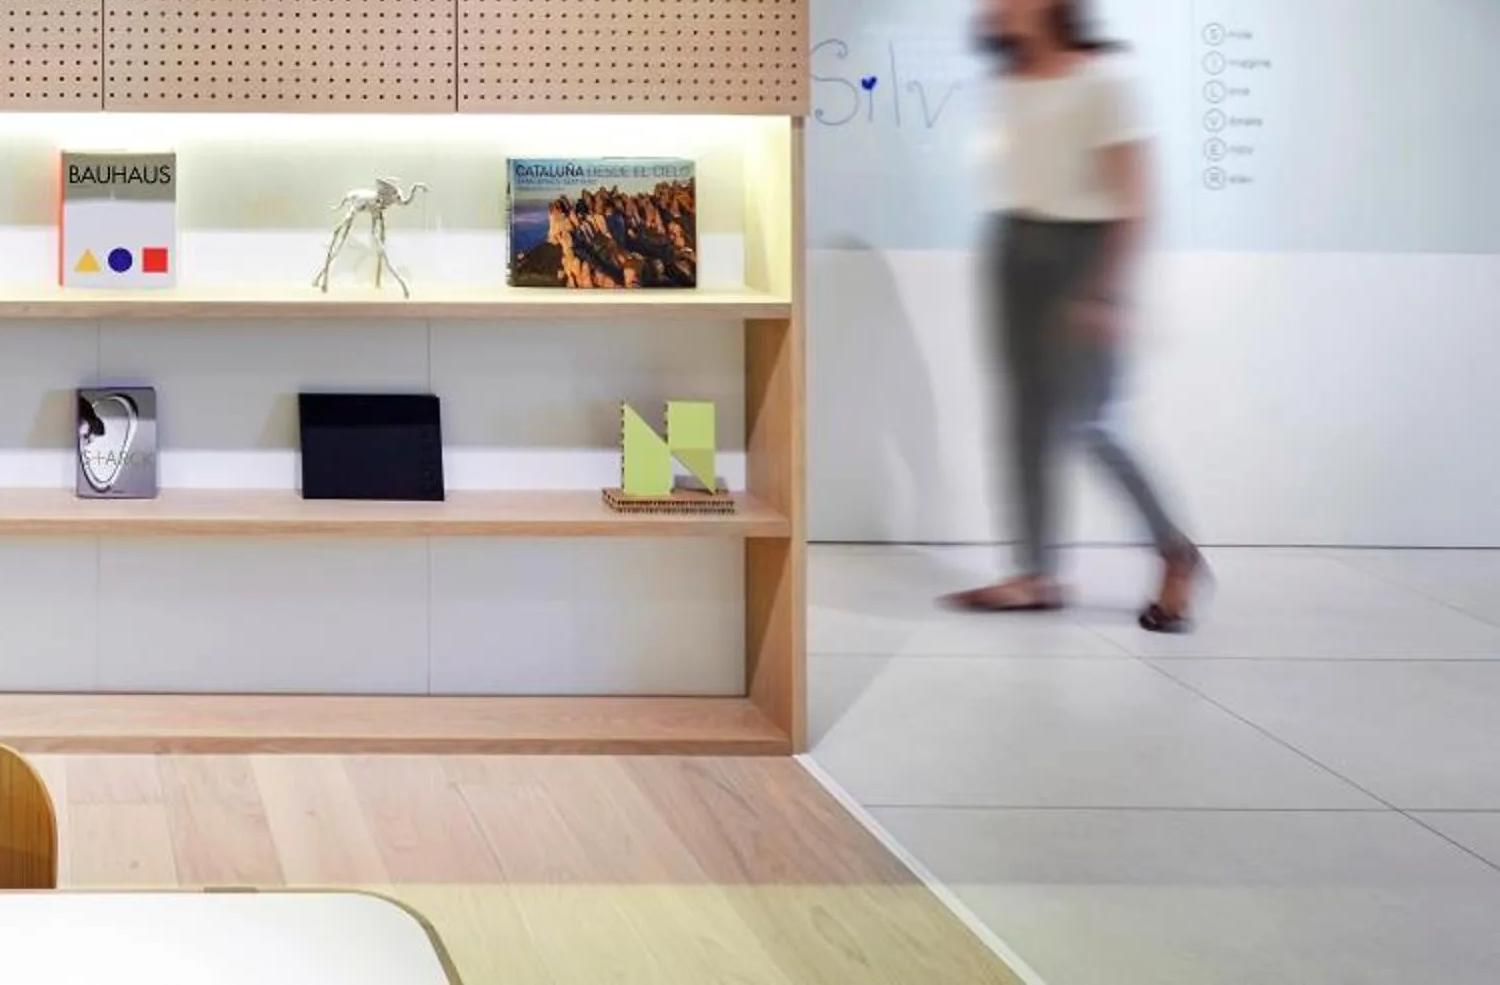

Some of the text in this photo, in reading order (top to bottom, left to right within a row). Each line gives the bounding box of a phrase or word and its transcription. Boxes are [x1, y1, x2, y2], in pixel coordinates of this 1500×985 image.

[69, 165, 171, 183] BAUHAUS
[515, 162, 584, 178] CATALUÑA
[653, 166, 691, 178] CIELO
